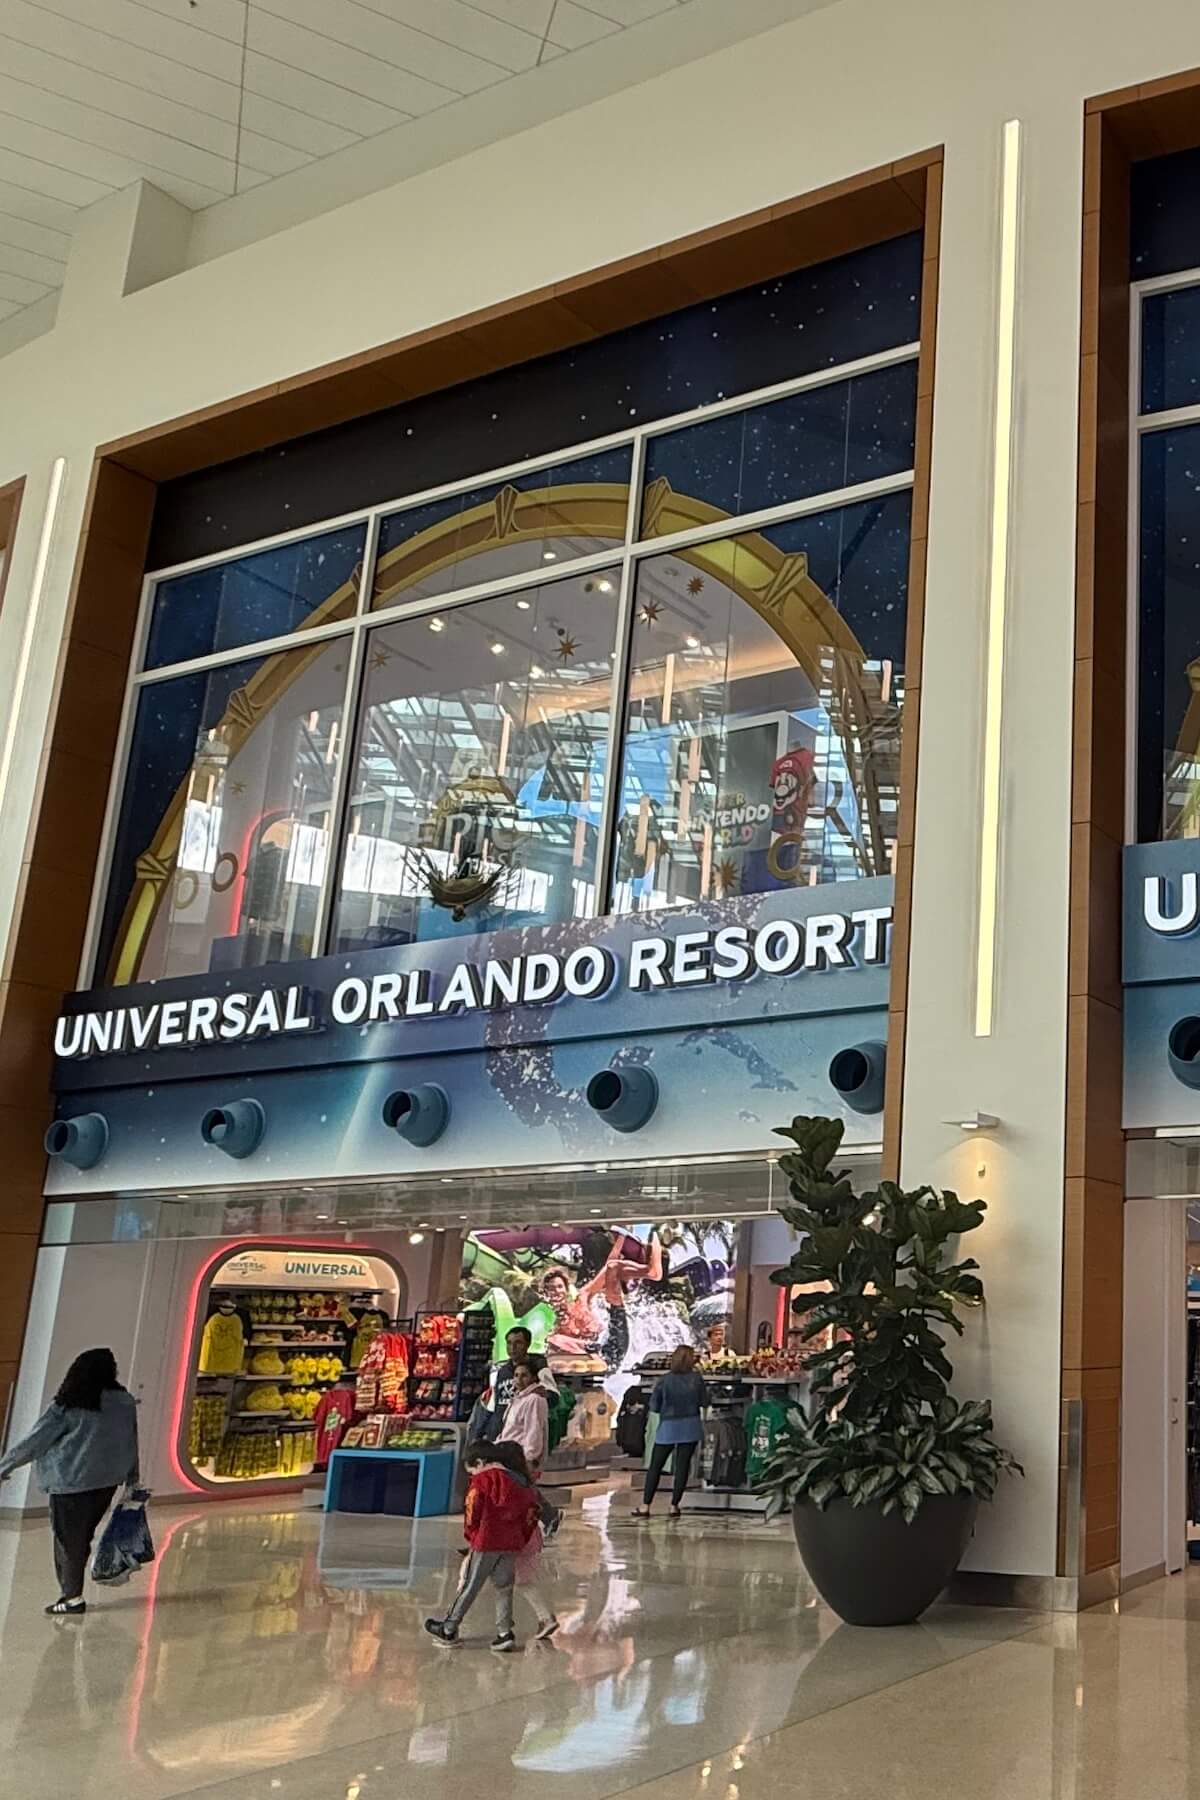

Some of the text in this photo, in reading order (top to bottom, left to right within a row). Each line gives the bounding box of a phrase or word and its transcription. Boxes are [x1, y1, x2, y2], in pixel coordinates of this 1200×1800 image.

[54, 906, 893, 1057] UNIVERSAL ORLANDO RESORT
[284, 1261, 367, 1277] UNIVERSAL
